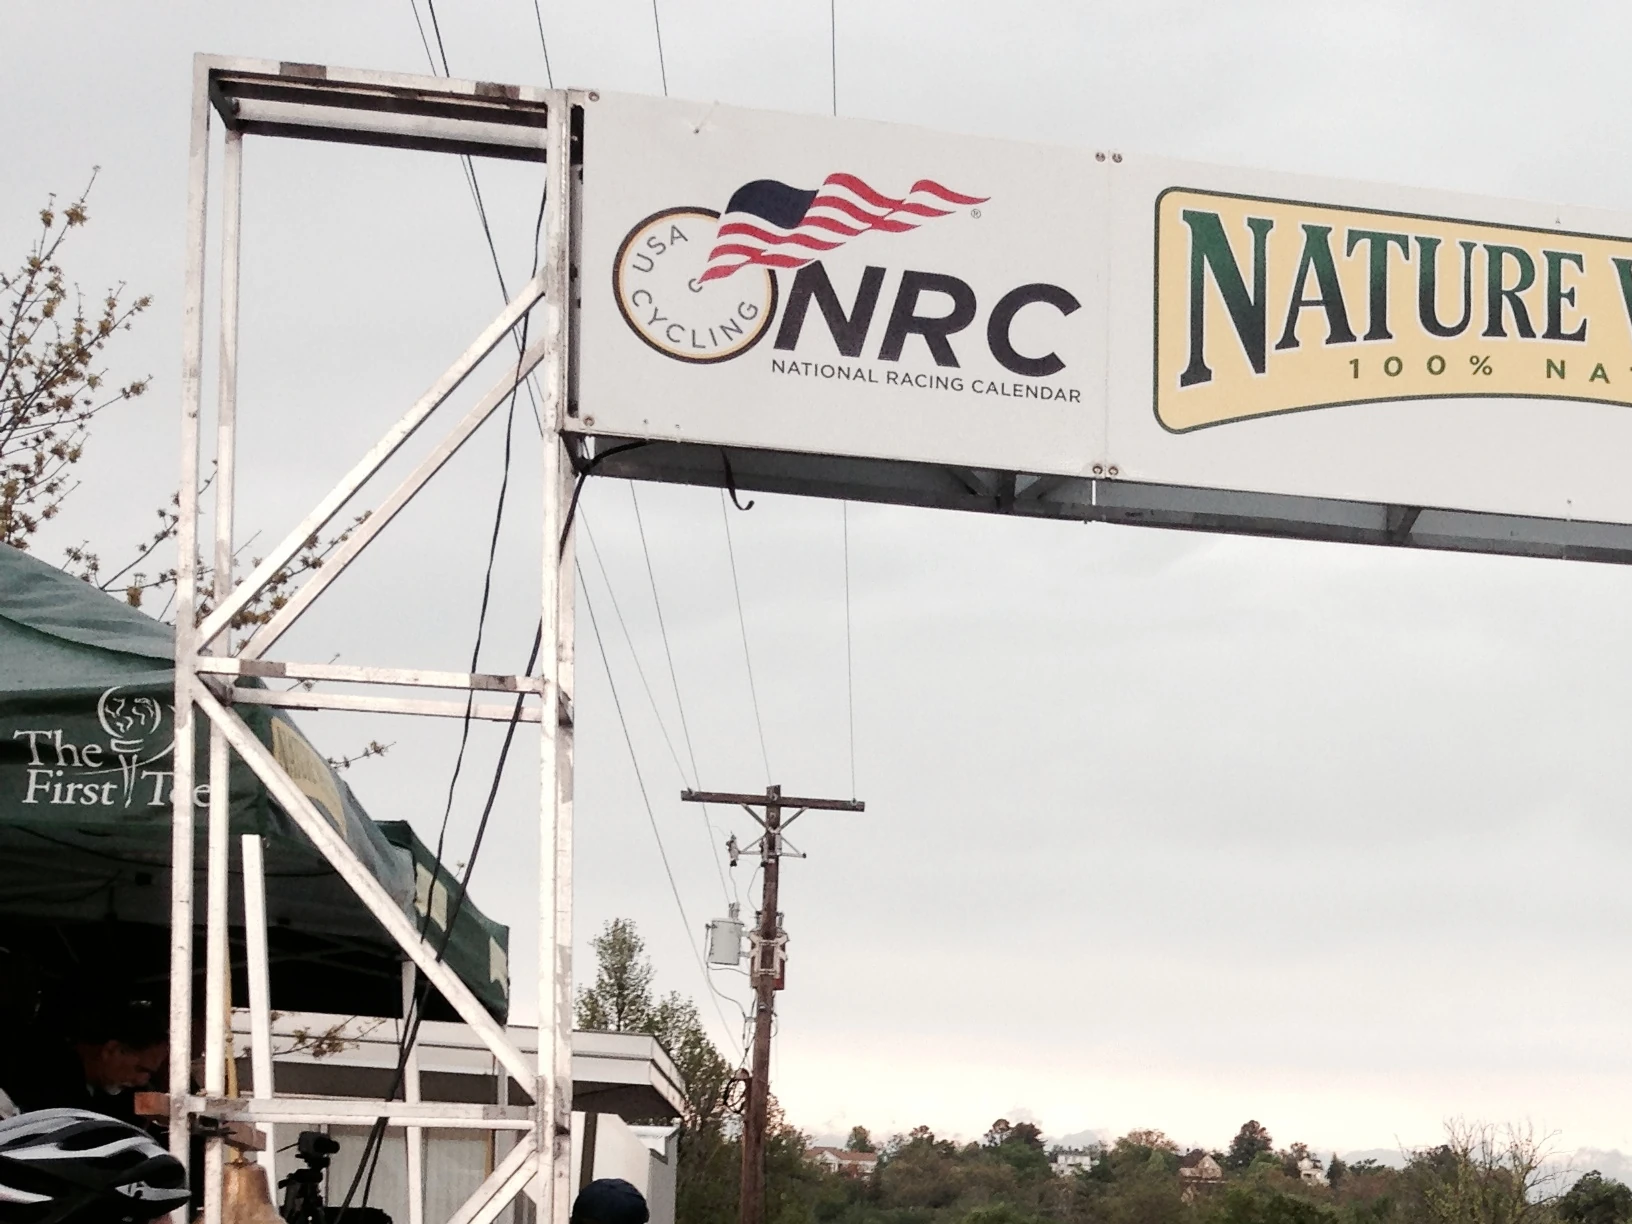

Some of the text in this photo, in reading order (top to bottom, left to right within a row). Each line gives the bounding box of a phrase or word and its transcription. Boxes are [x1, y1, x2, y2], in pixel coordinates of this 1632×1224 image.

[632, 224, 688, 273] USA
[632, 289, 758, 348] CYCLING
[773, 259, 1082, 378] NRC
[1180, 209, 1588, 388] NATURE
[772, 359, 1081, 404] NATIONAL RACING CALENDAR
[1348, 354, 1493, 379] 100%
[13, 729, 103, 768] The
[22, 768, 211, 808] First Te
